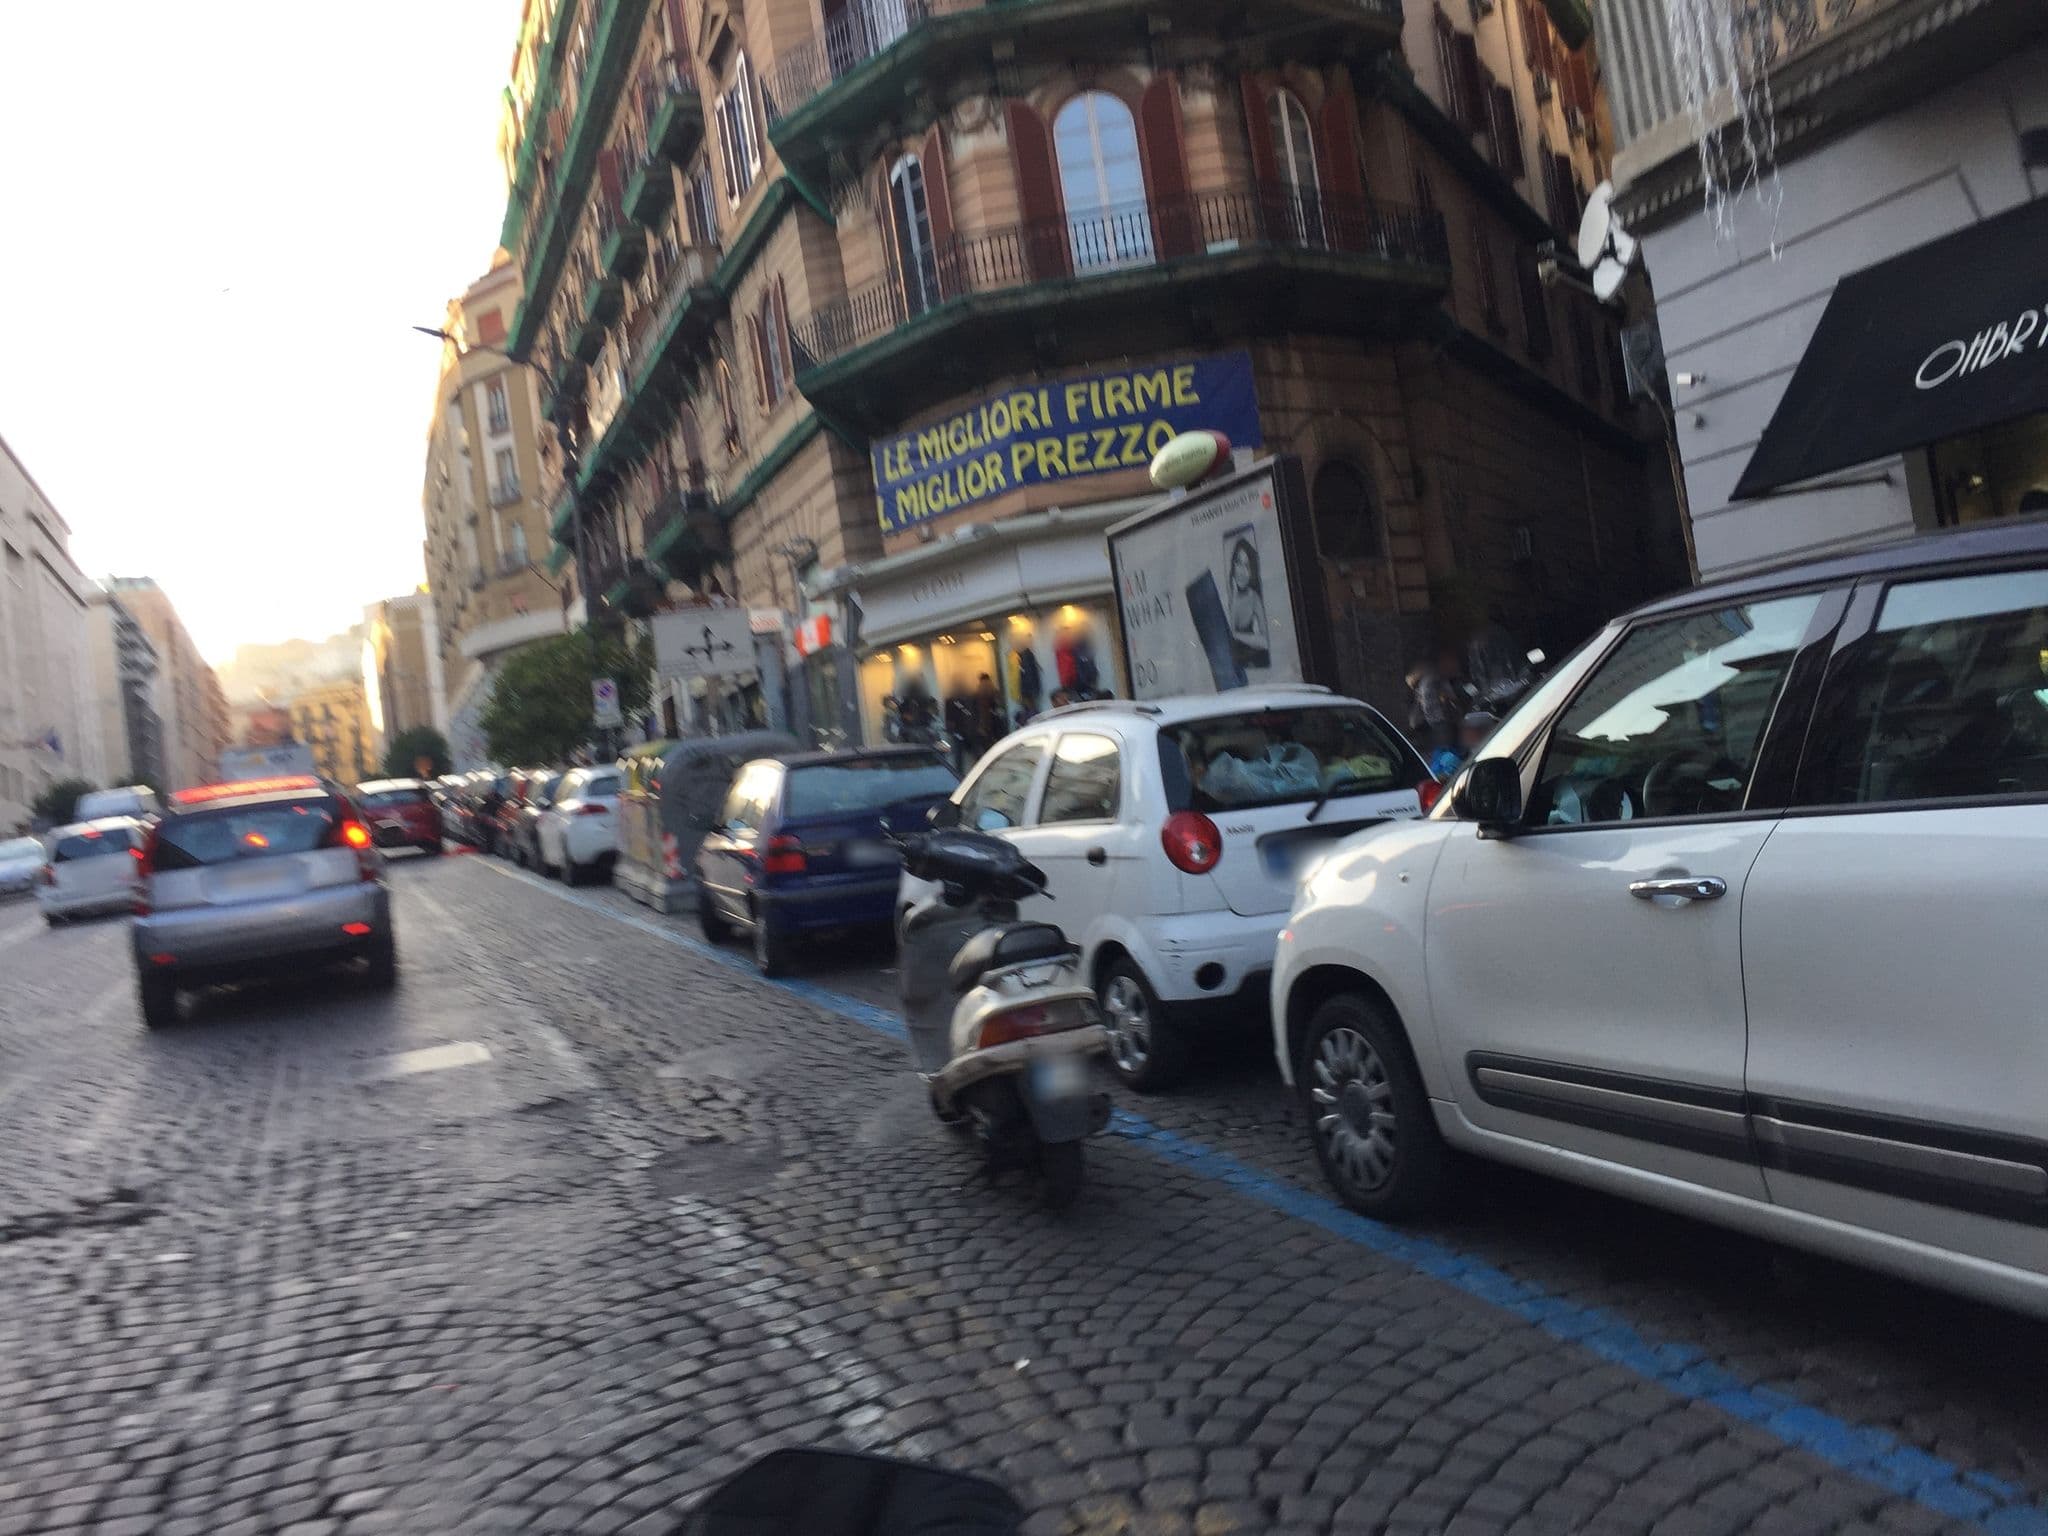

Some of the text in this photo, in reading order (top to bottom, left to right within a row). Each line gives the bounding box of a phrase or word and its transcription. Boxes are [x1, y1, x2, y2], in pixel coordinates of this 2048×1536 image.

[883, 438, 915, 482] LE
[917, 389, 1053, 470] MIGLIORI
[1065, 364, 1200, 424] FIRME
[896, 451, 1007, 524] MIGLIOR
[1010, 418, 1177, 483] PREZZO
